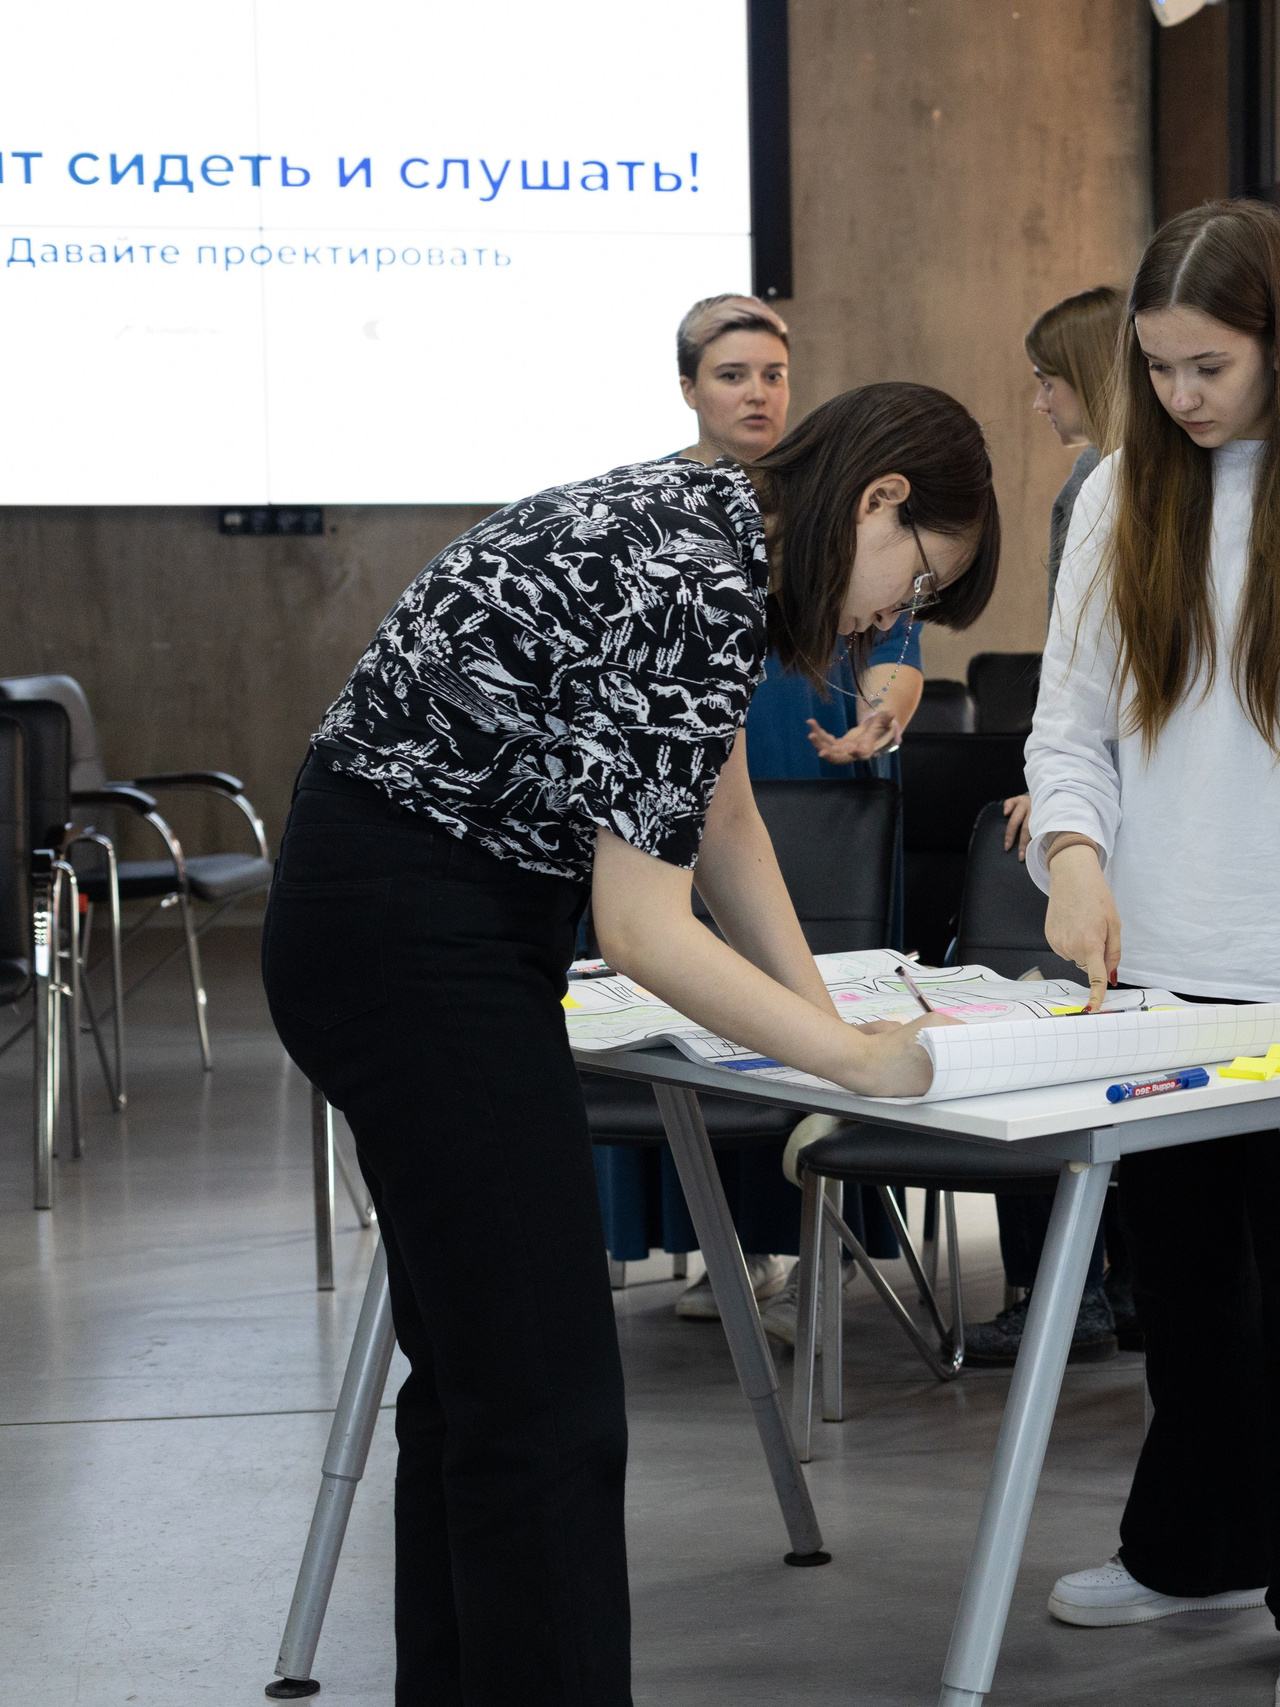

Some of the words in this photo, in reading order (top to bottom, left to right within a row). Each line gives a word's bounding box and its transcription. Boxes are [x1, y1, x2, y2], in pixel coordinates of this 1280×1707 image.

[67, 152, 311, 193] сидеть
[338, 156, 373, 188] и
[399, 152, 700, 202] слушать!
[6, 236, 180, 268] Давайте
[197, 243, 512, 272] проектировать
[1135, 1085, 1151, 1096] 360
[1152, 1081, 1176, 1093] edding
